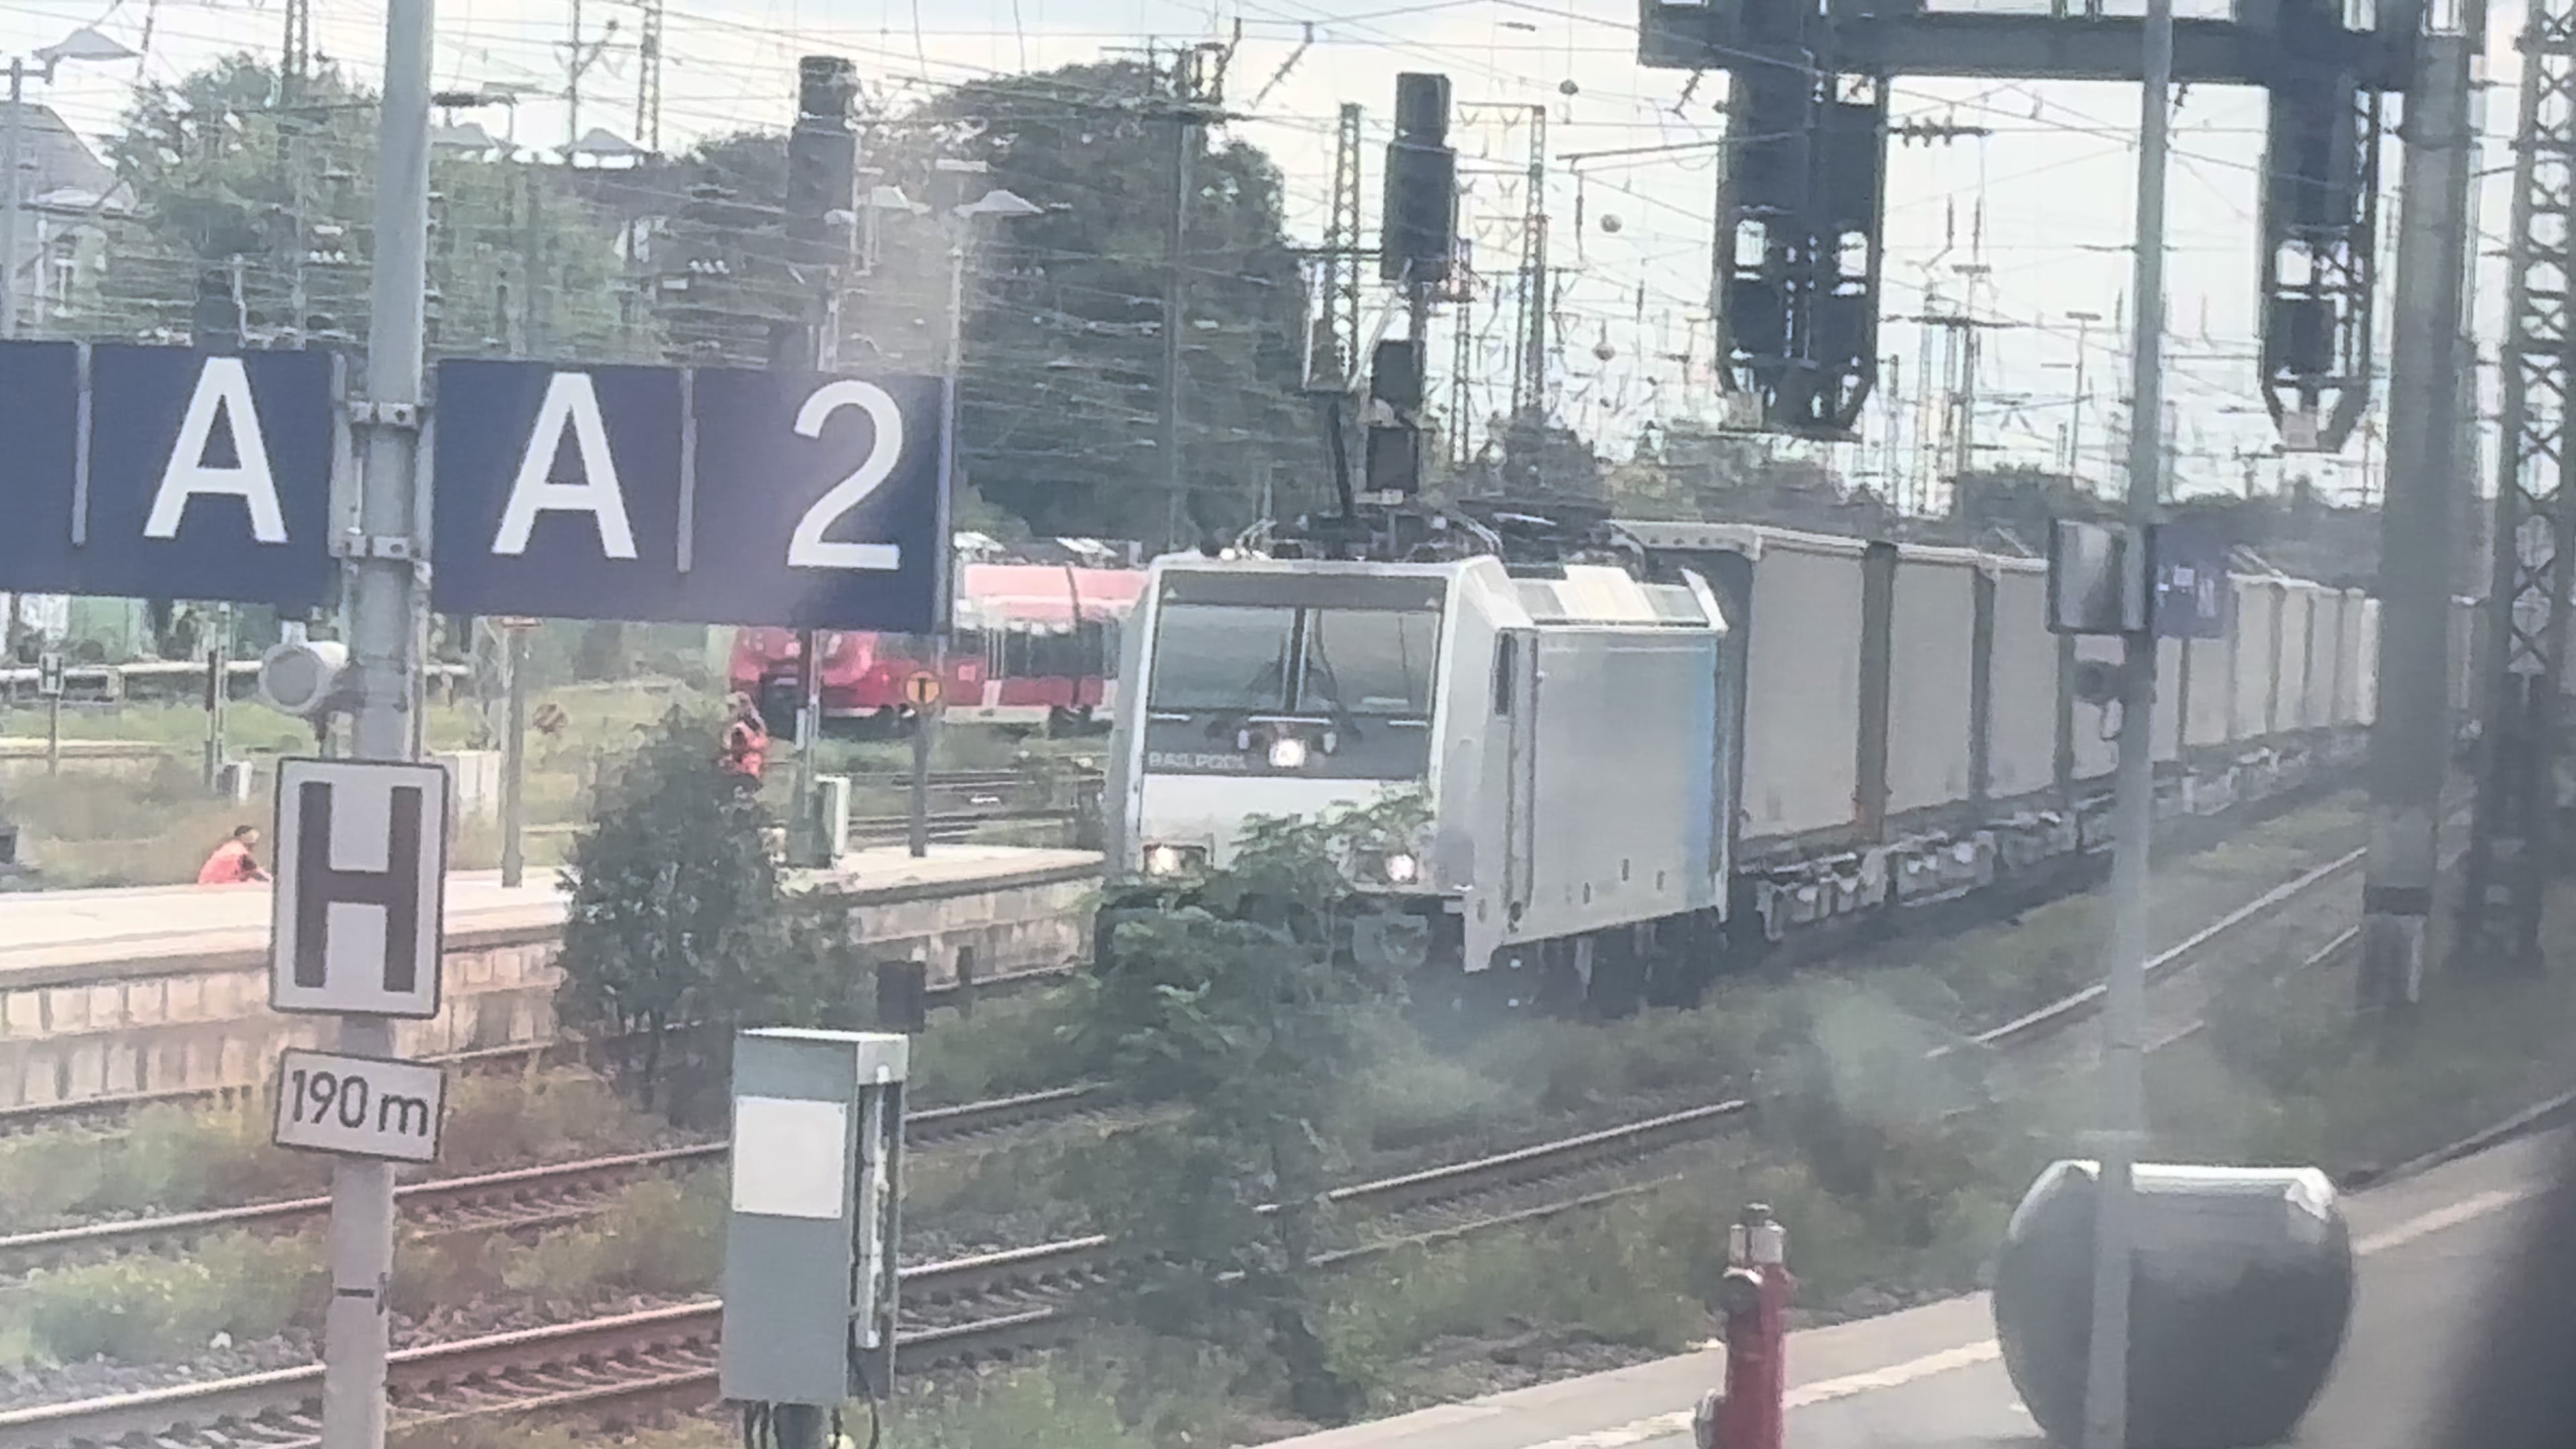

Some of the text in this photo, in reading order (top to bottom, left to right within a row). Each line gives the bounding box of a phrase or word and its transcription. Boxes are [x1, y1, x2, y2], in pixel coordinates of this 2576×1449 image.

[144, 357, 288, 543] A
[491, 372, 903, 570] A 2
[294, 781, 422, 993] H
[291, 1069, 429, 1136] 190 m
